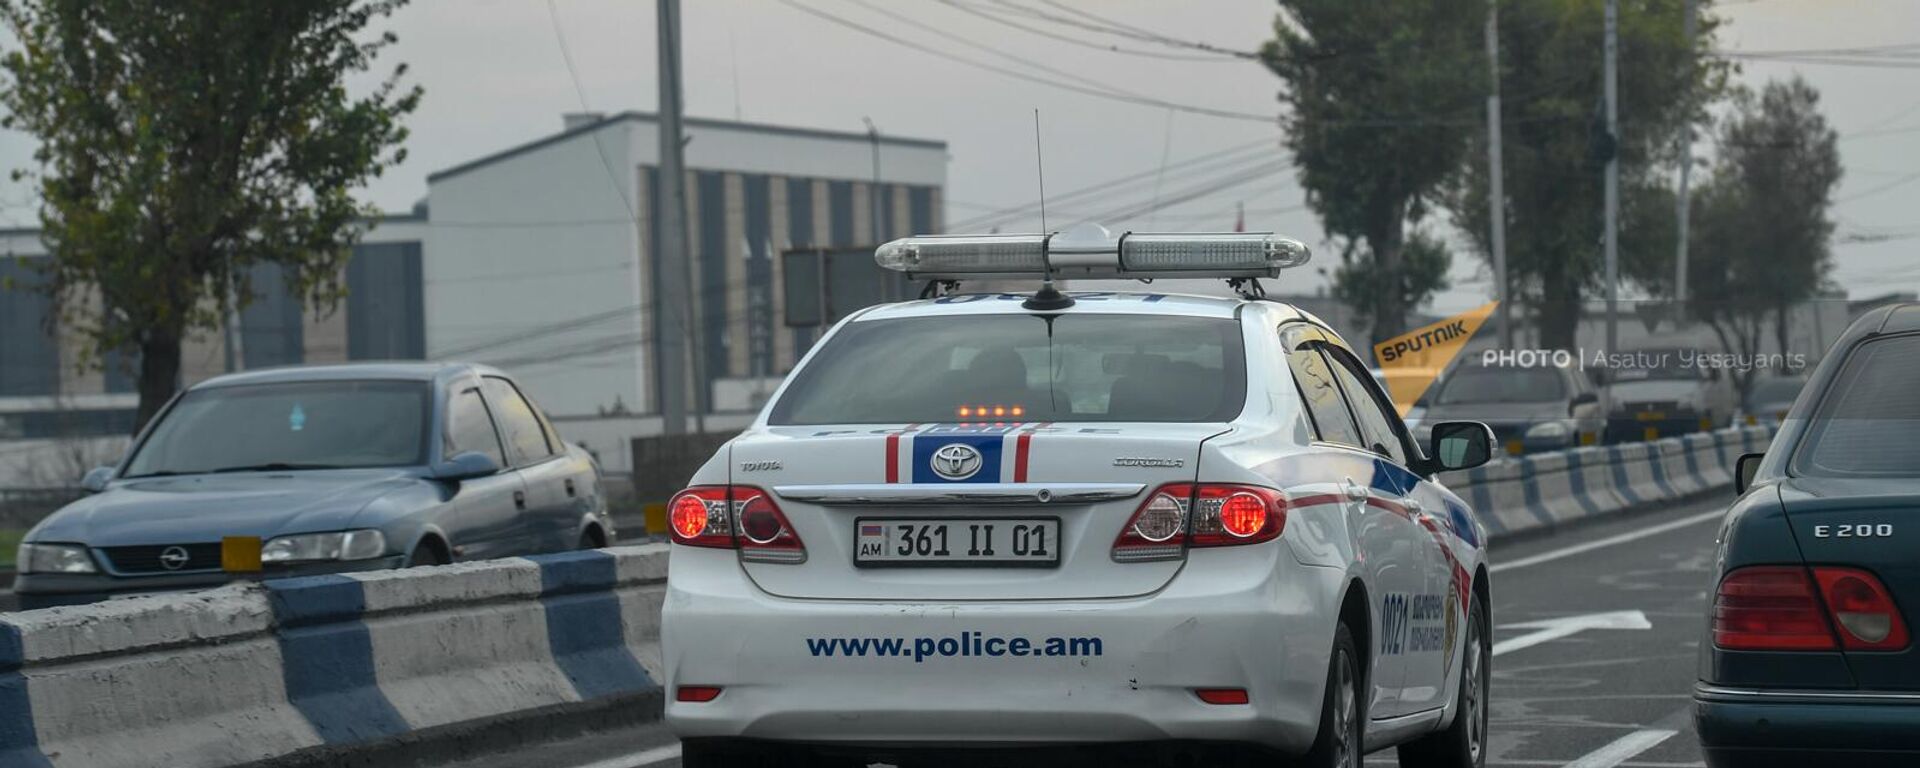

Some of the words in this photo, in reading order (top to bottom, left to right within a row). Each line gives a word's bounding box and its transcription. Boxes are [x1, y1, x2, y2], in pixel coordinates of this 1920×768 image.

[898, 525, 949, 556] 361
[1012, 525, 1047, 556] 01
[1814, 525, 1830, 537] E
[1837, 524, 1893, 537] 200
[860, 543, 882, 556] AM
[1381, 593, 1409, 656] 0021
[806, 631, 1103, 662] www.police.am
